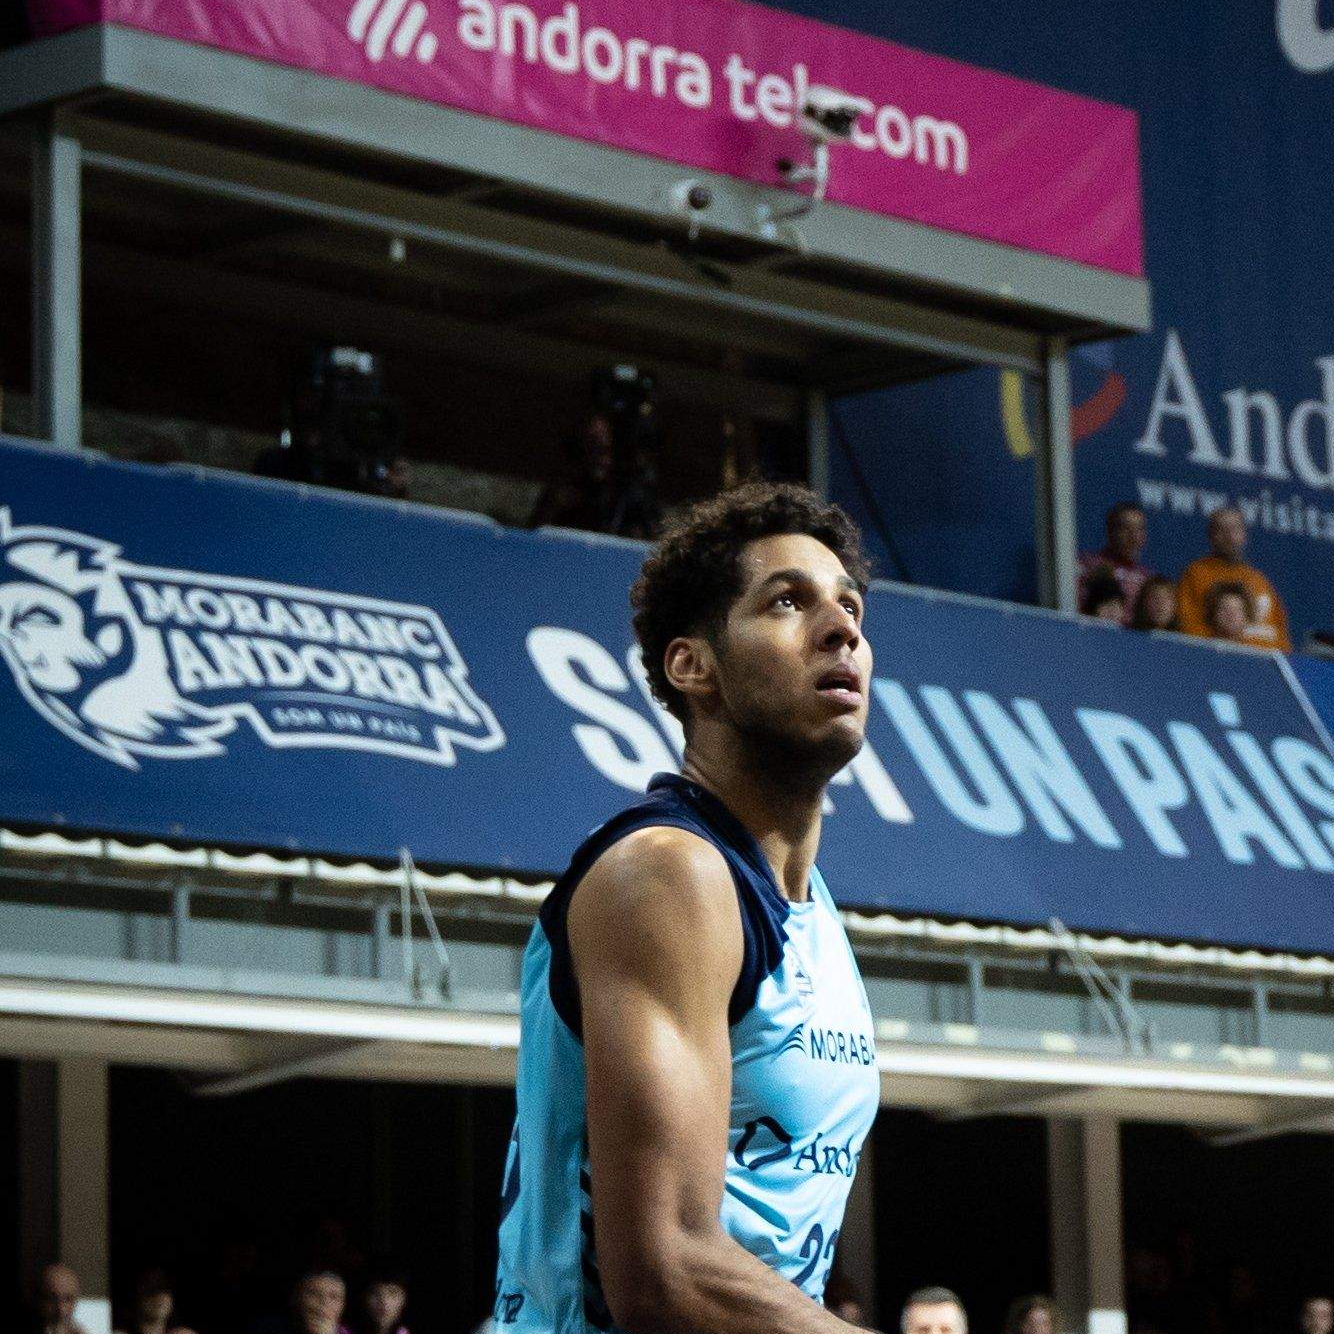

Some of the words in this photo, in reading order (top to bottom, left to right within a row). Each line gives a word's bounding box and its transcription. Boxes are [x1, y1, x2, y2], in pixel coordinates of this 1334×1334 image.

[130, 581, 442, 659] MORABANC
[168, 628, 481, 725] ANDORRA
[872, 677, 1123, 851] UN
